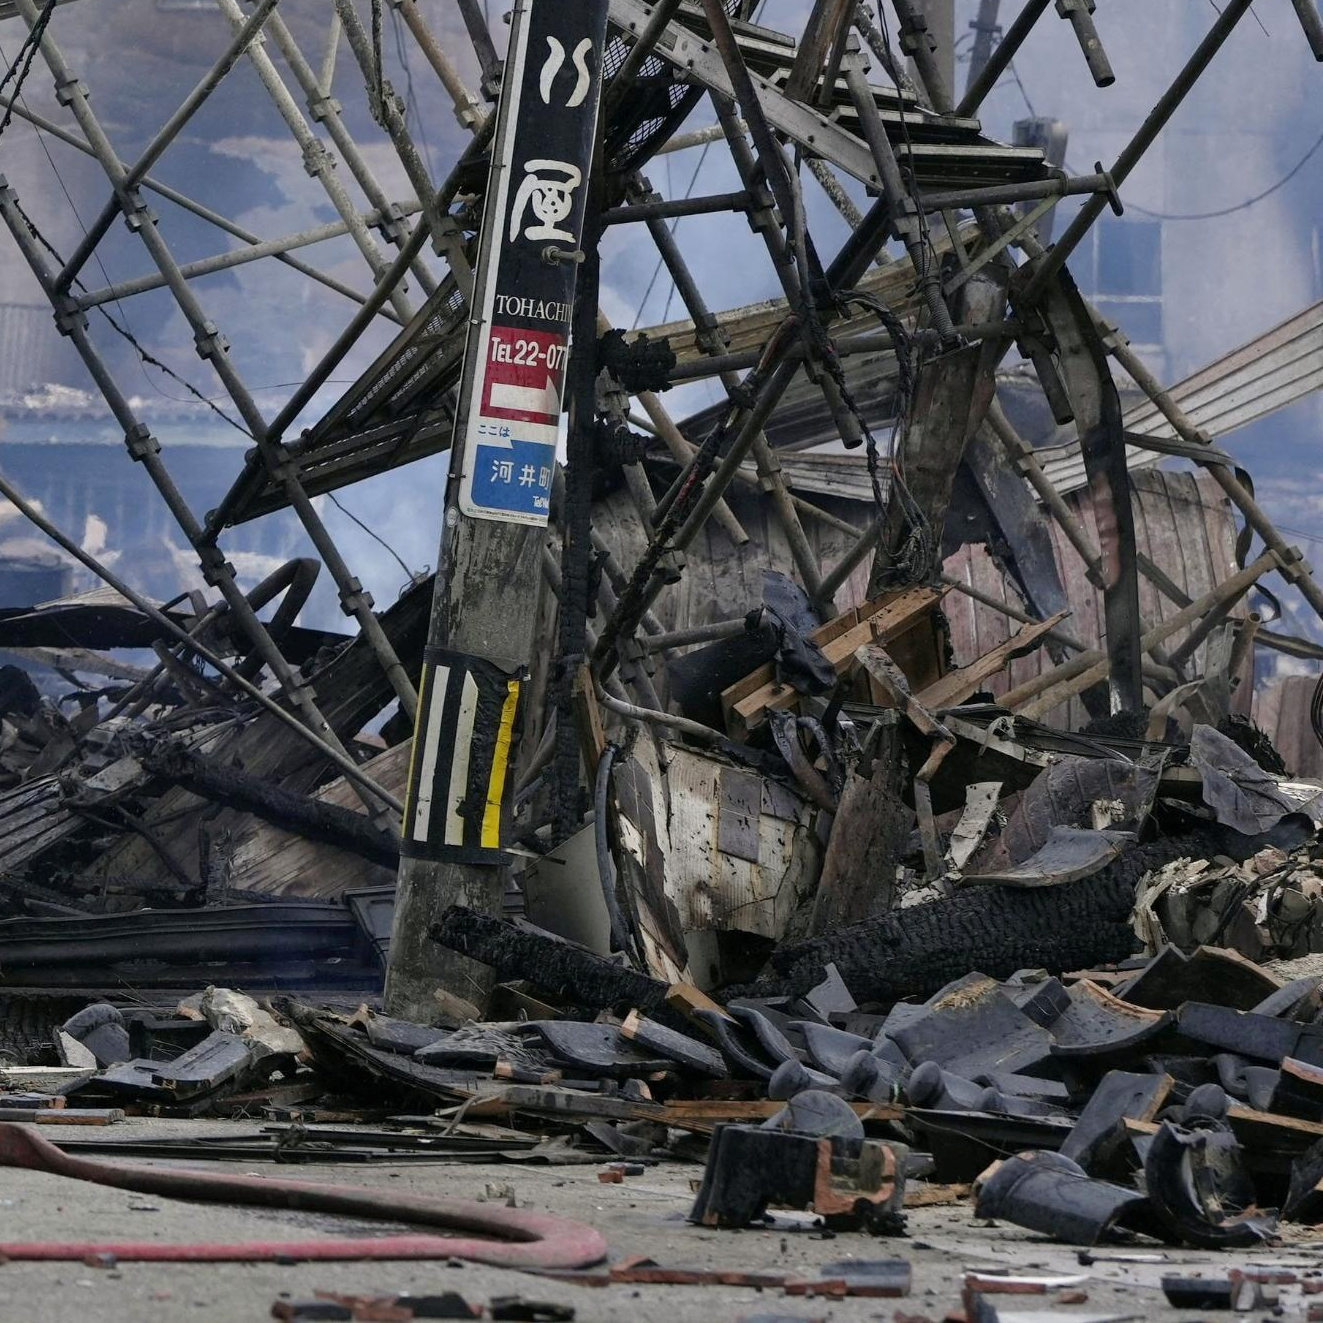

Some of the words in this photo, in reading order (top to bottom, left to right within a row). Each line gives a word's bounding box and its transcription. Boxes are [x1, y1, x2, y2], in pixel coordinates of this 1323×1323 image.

[478, 424, 510, 438] ここは
[490, 459, 551, 490] 河井町
